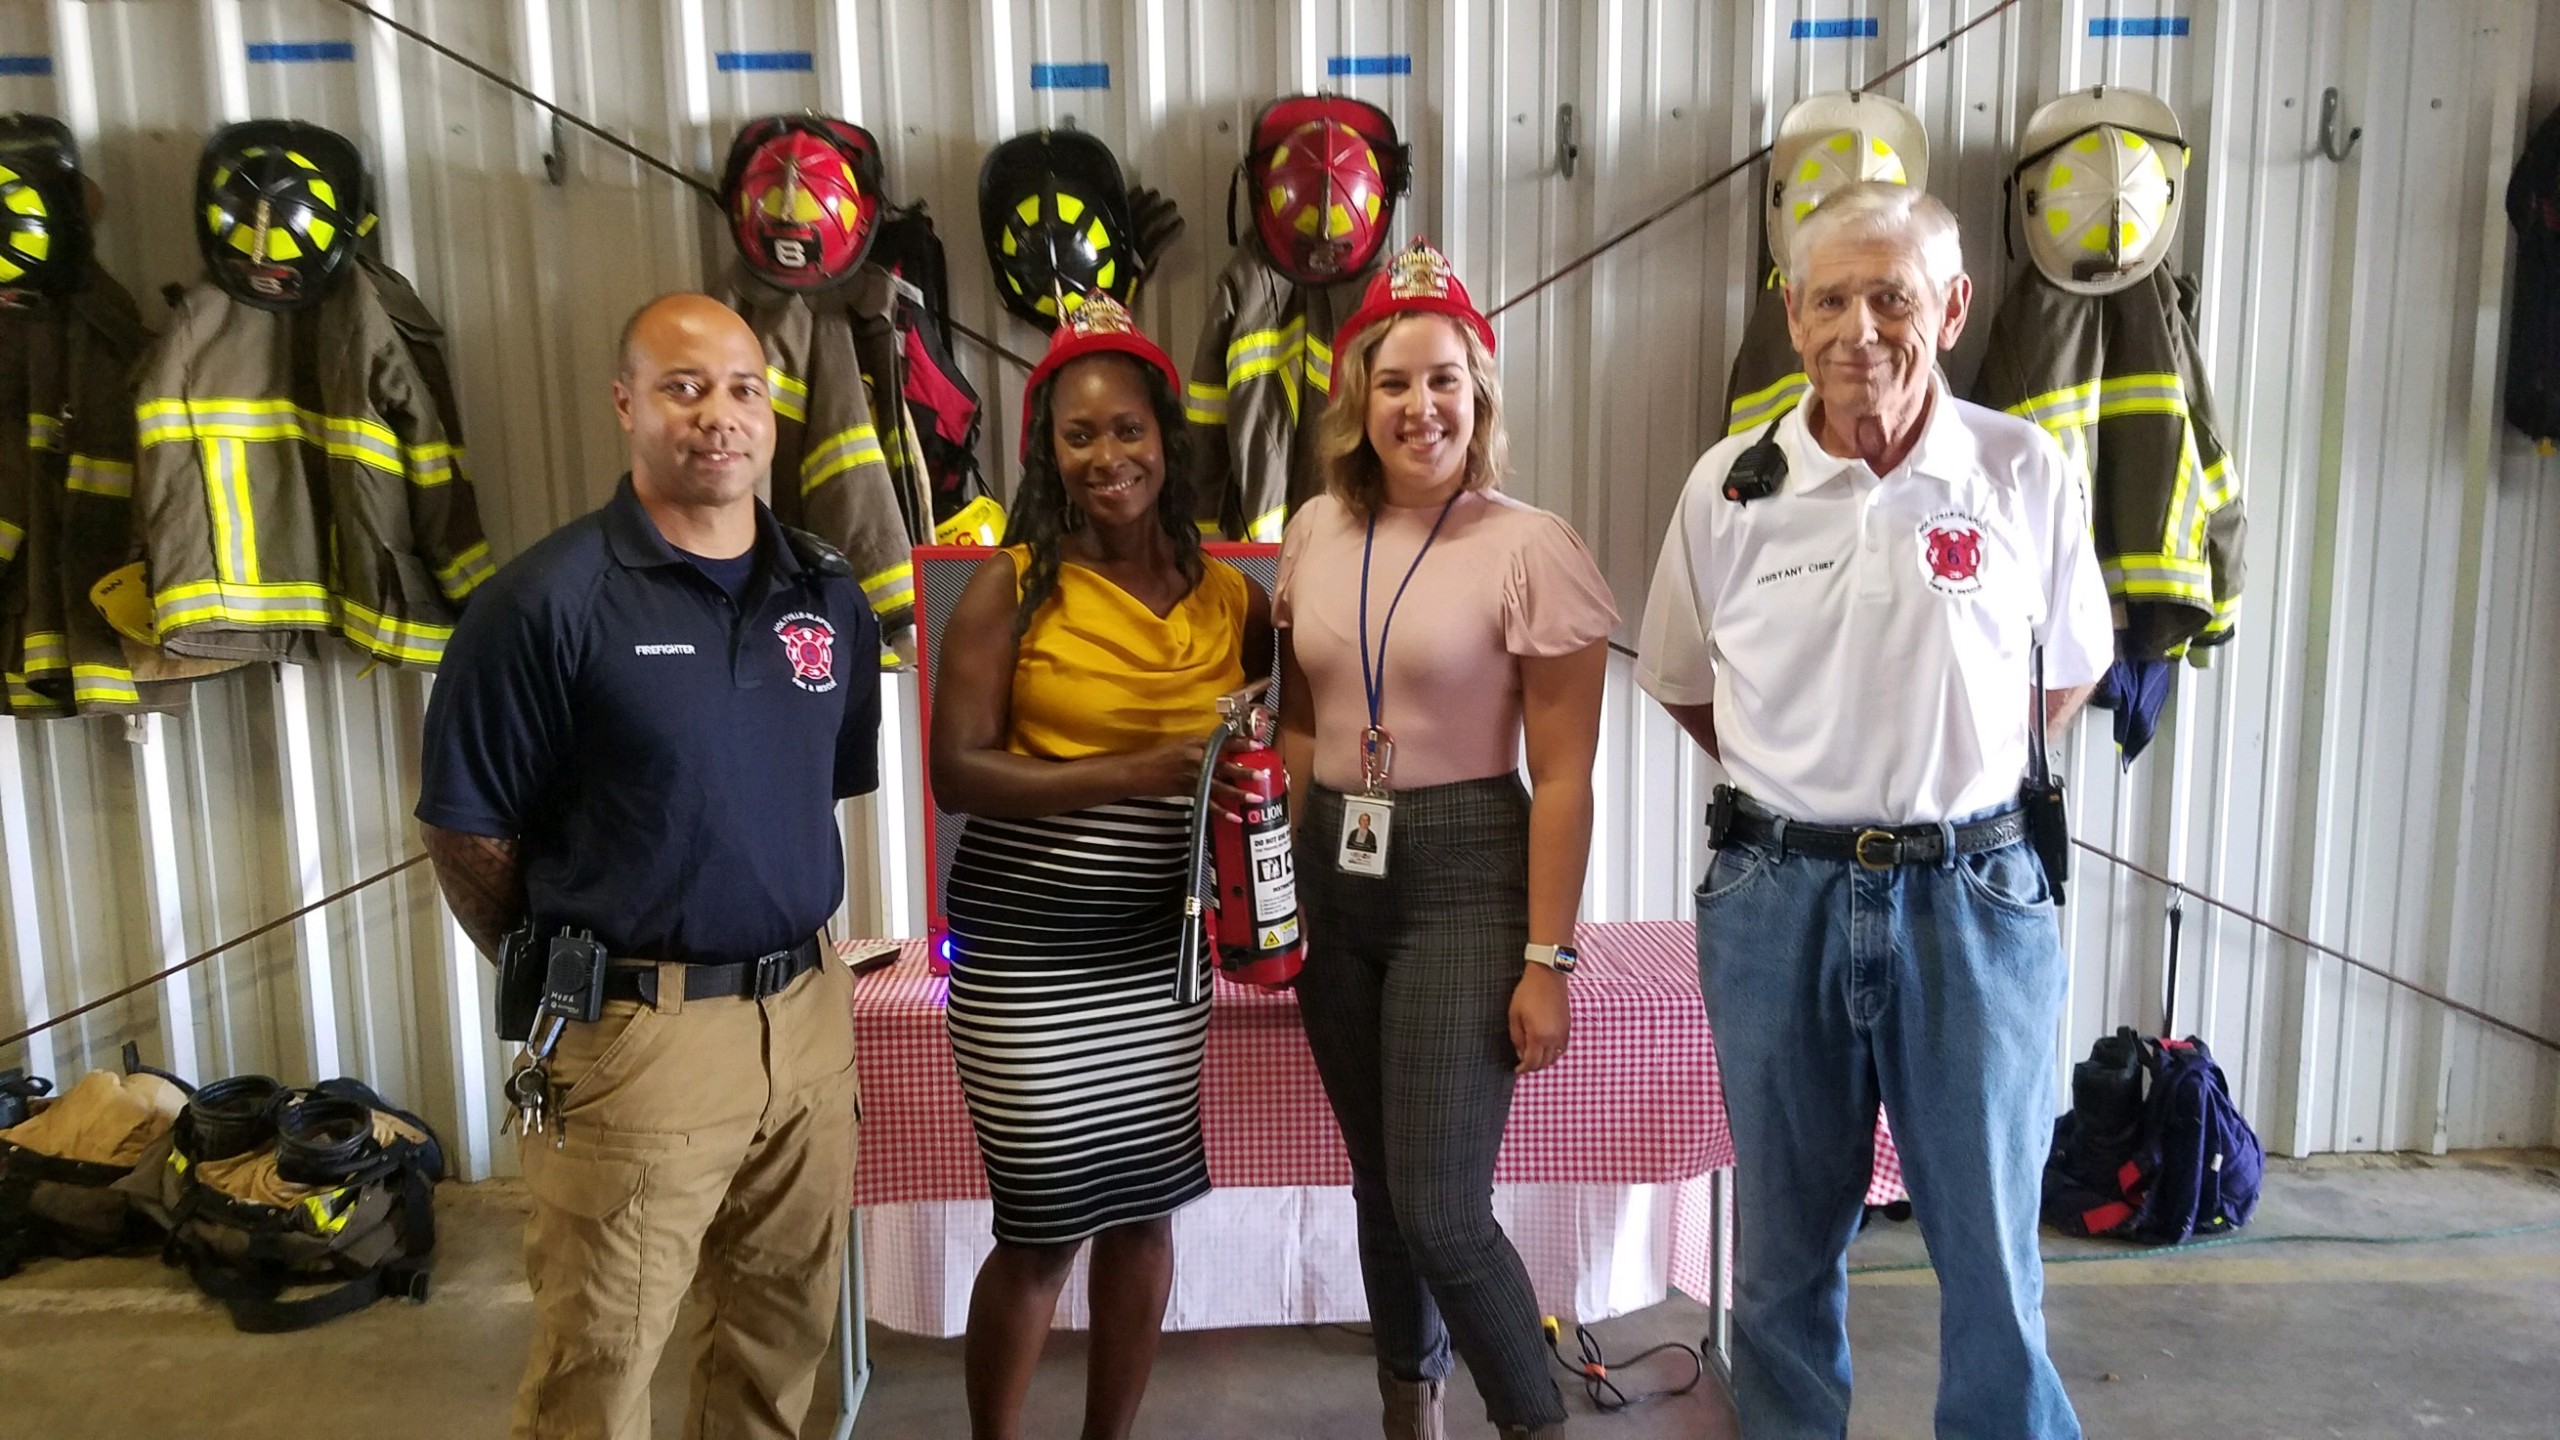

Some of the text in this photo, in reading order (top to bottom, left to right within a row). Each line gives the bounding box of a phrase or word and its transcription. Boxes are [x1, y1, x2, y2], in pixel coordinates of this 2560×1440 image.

[774, 239, 808, 268] 6
[635, 644, 696, 656] FIREFIGHTER
[1261, 803, 1283, 821] LION
[1265, 836, 1277, 845] NOT
